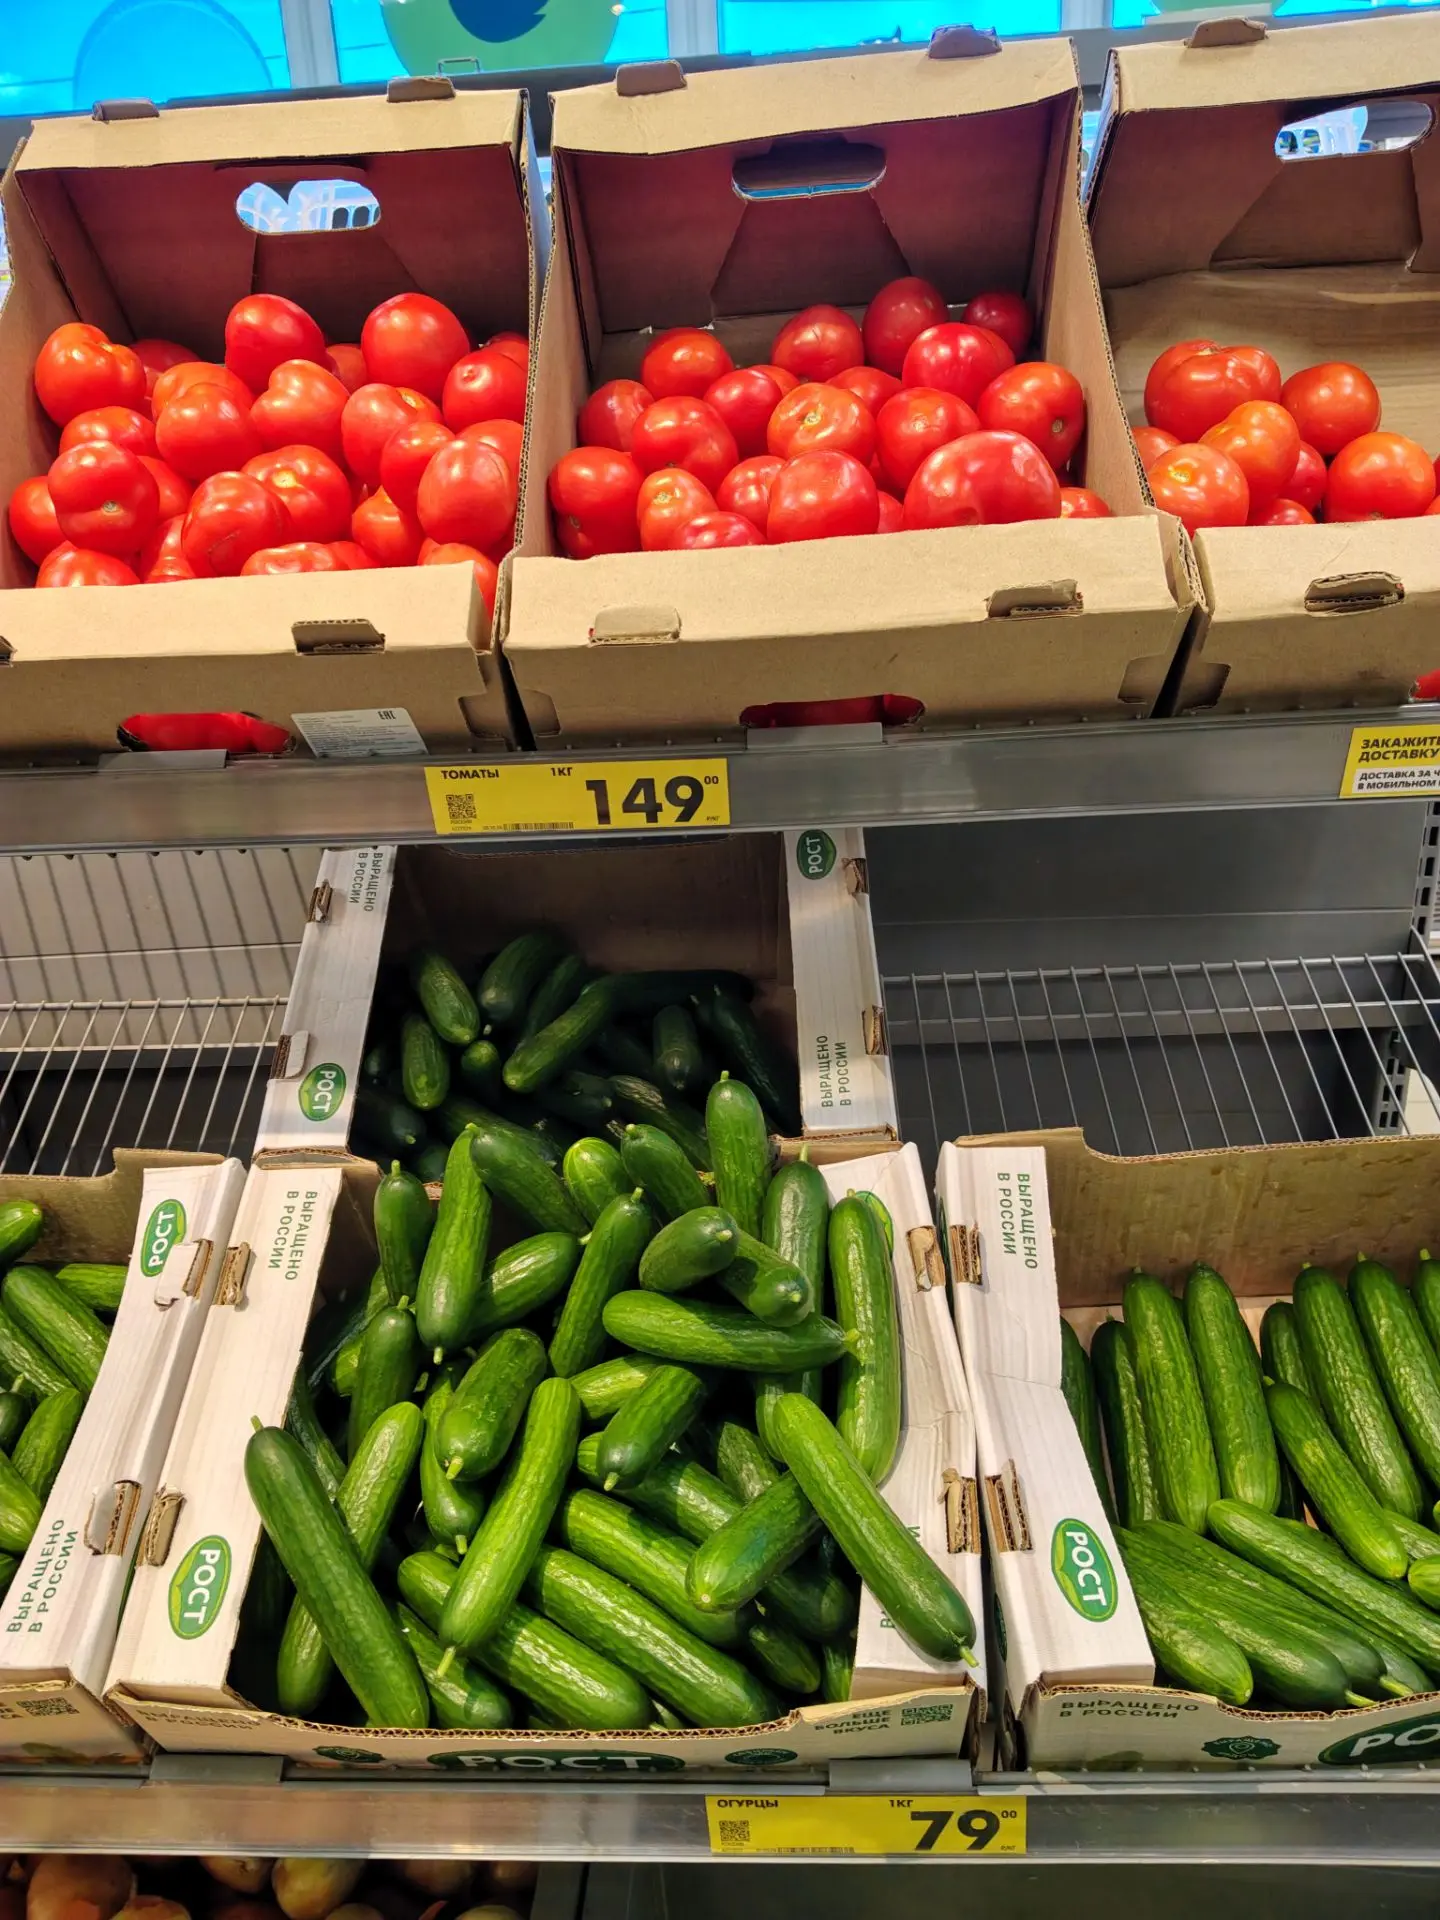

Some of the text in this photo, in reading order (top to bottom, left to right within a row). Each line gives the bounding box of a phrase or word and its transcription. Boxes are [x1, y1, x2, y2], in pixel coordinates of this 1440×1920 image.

[441, 769, 499, 780] ТОМАТЫ
[1358, 748, 1439, 763] ДОСТАВКУ
[1359, 770, 1416, 781] ДОСТАВКА
[1418, 770, 1431, 778] ЗА
[585, 776, 719, 825] 149 00
[1357, 782, 1364, 790] В
[1367, 780, 1436, 790] МОБИЛЬНОМ
[806, 836, 823, 874] РОСТ
[349, 862, 367, 904] РОССИИ
[363, 852, 384, 912] ВЫРАЩЕНО
[816, 1035, 834, 1108] ВЫРАЩЕНО
[835, 1041, 850, 1094] РОССИИ
[312, 1070, 337, 1113] РОСТ
[268, 1190, 300, 1270] В РОССИИ
[997, 1172, 1017, 1255] В РОССИИ
[1017, 1173, 1038, 1270] ВЫРАЩЕНО
[148, 1211, 176, 1268] РОСТ
[285, 1190, 318, 1281] ВЫРАЩЕНО
[6, 1519, 65, 1634] ВЫРАЩЕНО
[27, 1530, 79, 1634] В РОССИИ
[183, 1549, 222, 1625] РОСТ
[1065, 1531, 1108, 1606] РОСТ
[815, 1717, 891, 1731] БОЛЬШЕ
[852, 1709, 892, 1719] ЕЩЕ
[1061, 1700, 1200, 1712] ВЫРАЩЕНО
[1082, 1709, 1178, 1718] РОССИИ
[833, 1723, 891, 1735] ВКУСА
[457, 1755, 651, 1769] РОСТ
[717, 1799, 779, 1808] ОГУРЦЫ
[910, 1809, 1017, 1850] 79 00
